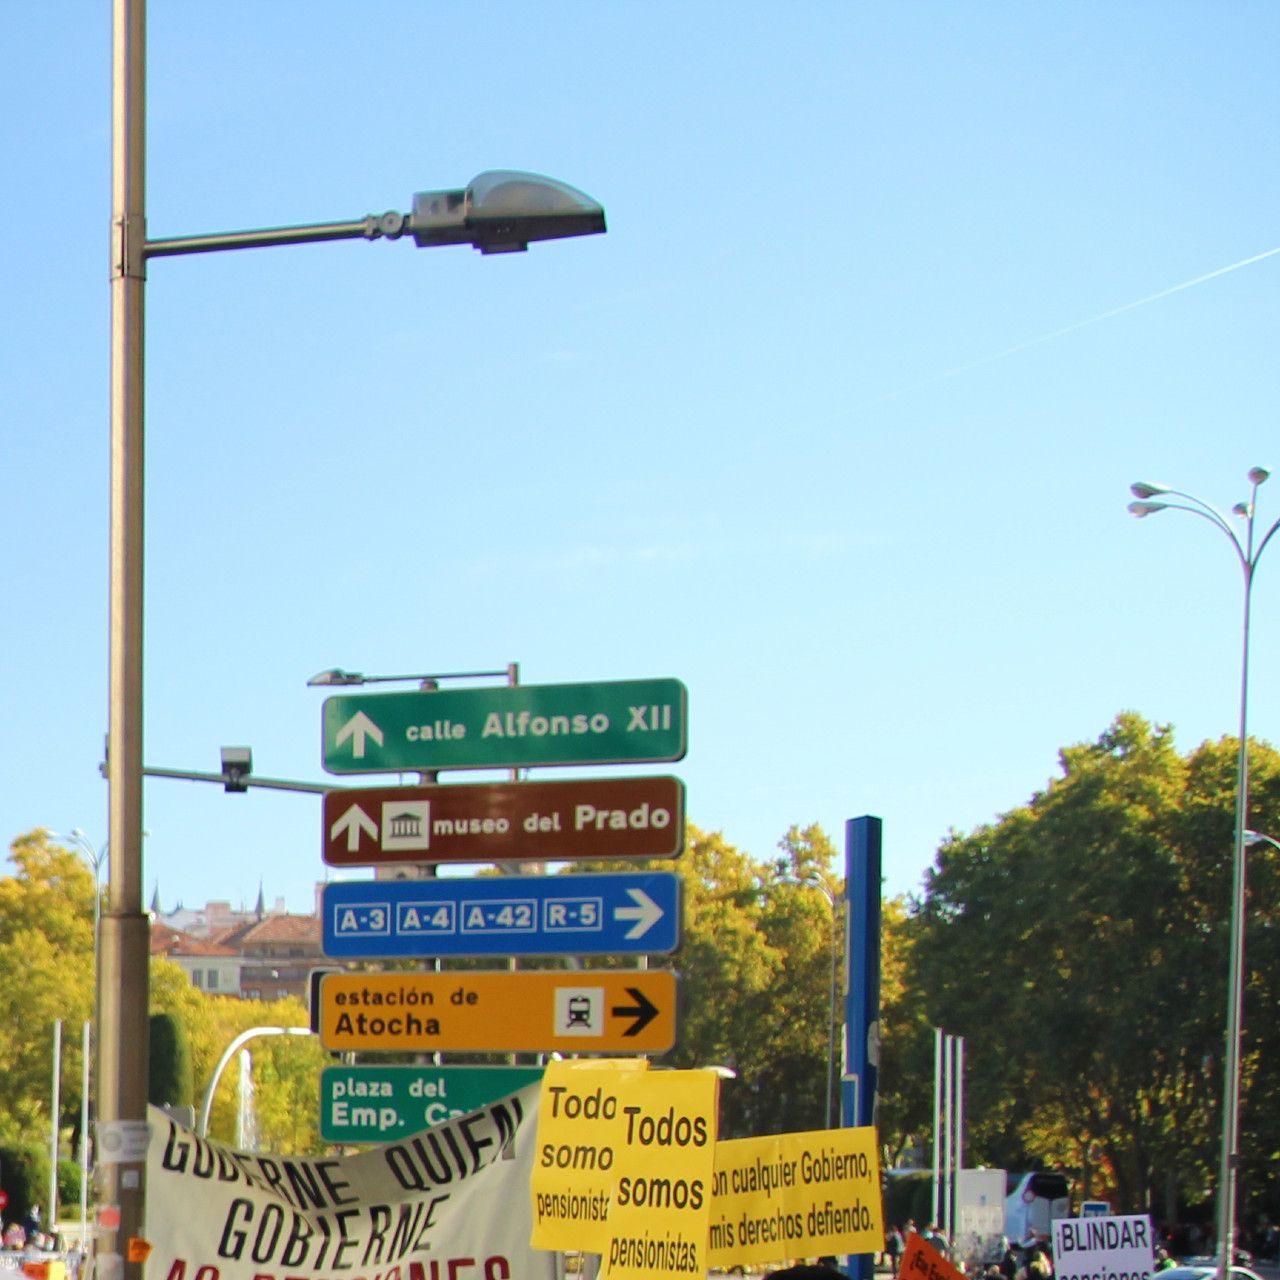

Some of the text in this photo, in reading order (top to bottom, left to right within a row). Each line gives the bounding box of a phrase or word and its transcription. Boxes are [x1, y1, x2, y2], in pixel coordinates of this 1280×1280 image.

[405, 704, 671, 743] calle Alfonso XII
[433, 803, 671, 836] museo del Prado
[340, 910, 386, 930] A-3
[401, 909, 451, 930] A-4
[466, 904, 533, 928] A-42
[549, 902, 598, 926] R-5
[334, 986, 479, 1007] estación de
[334, 1011, 441, 1037] Atocha
[332, 1077, 447, 1102] plaza del
[332, 1102, 405, 1131] Emp.
[623, 1106, 708, 1148] Todos
[731, 1153, 798, 1199] cualquier
[800, 1147, 872, 1185] Gobierno,
[618, 1175, 704, 1212] somos
[218, 1193, 451, 1271] GOBIERNE
[710, 1198, 875, 1250] mis derechos defiendo.
[1057, 1219, 1149, 1260] ¡BLINDAR
[608, 1231, 700, 1277] pensionistas.
